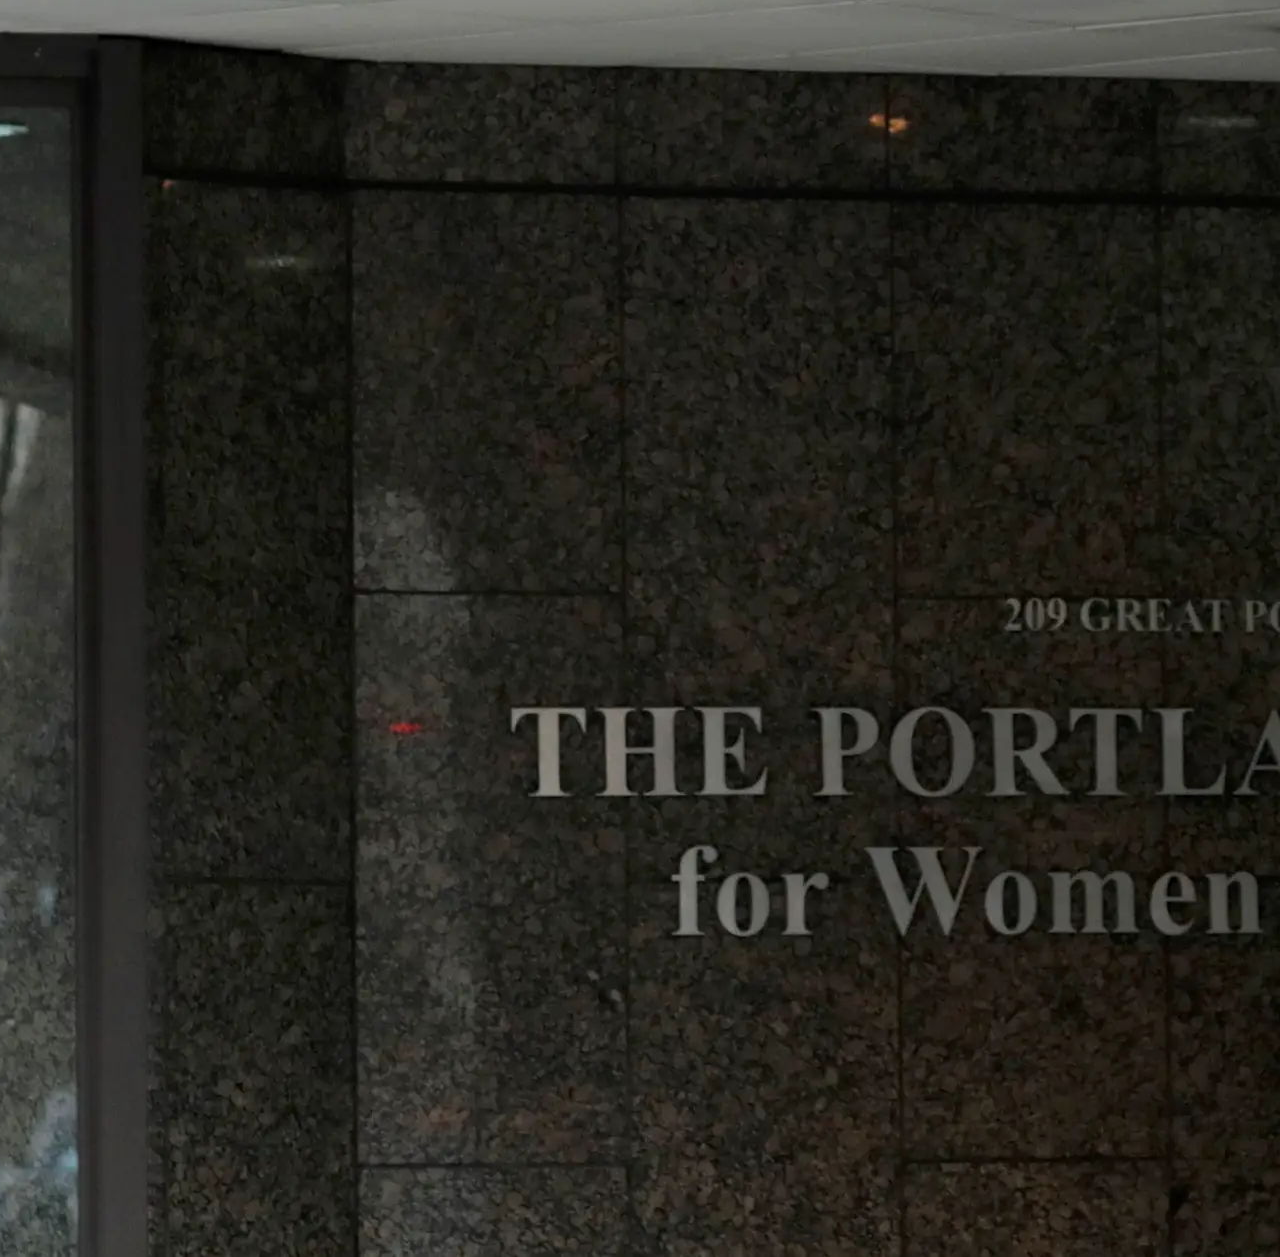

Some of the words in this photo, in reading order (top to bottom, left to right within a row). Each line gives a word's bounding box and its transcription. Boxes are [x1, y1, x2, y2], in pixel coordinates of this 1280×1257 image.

[1004, 596, 1068, 634] 209
[1080, 598, 1232, 634] GREAT
[510, 705, 770, 798] THE
[670, 844, 830, 938] for
[864, 844, 1264, 938] Women
